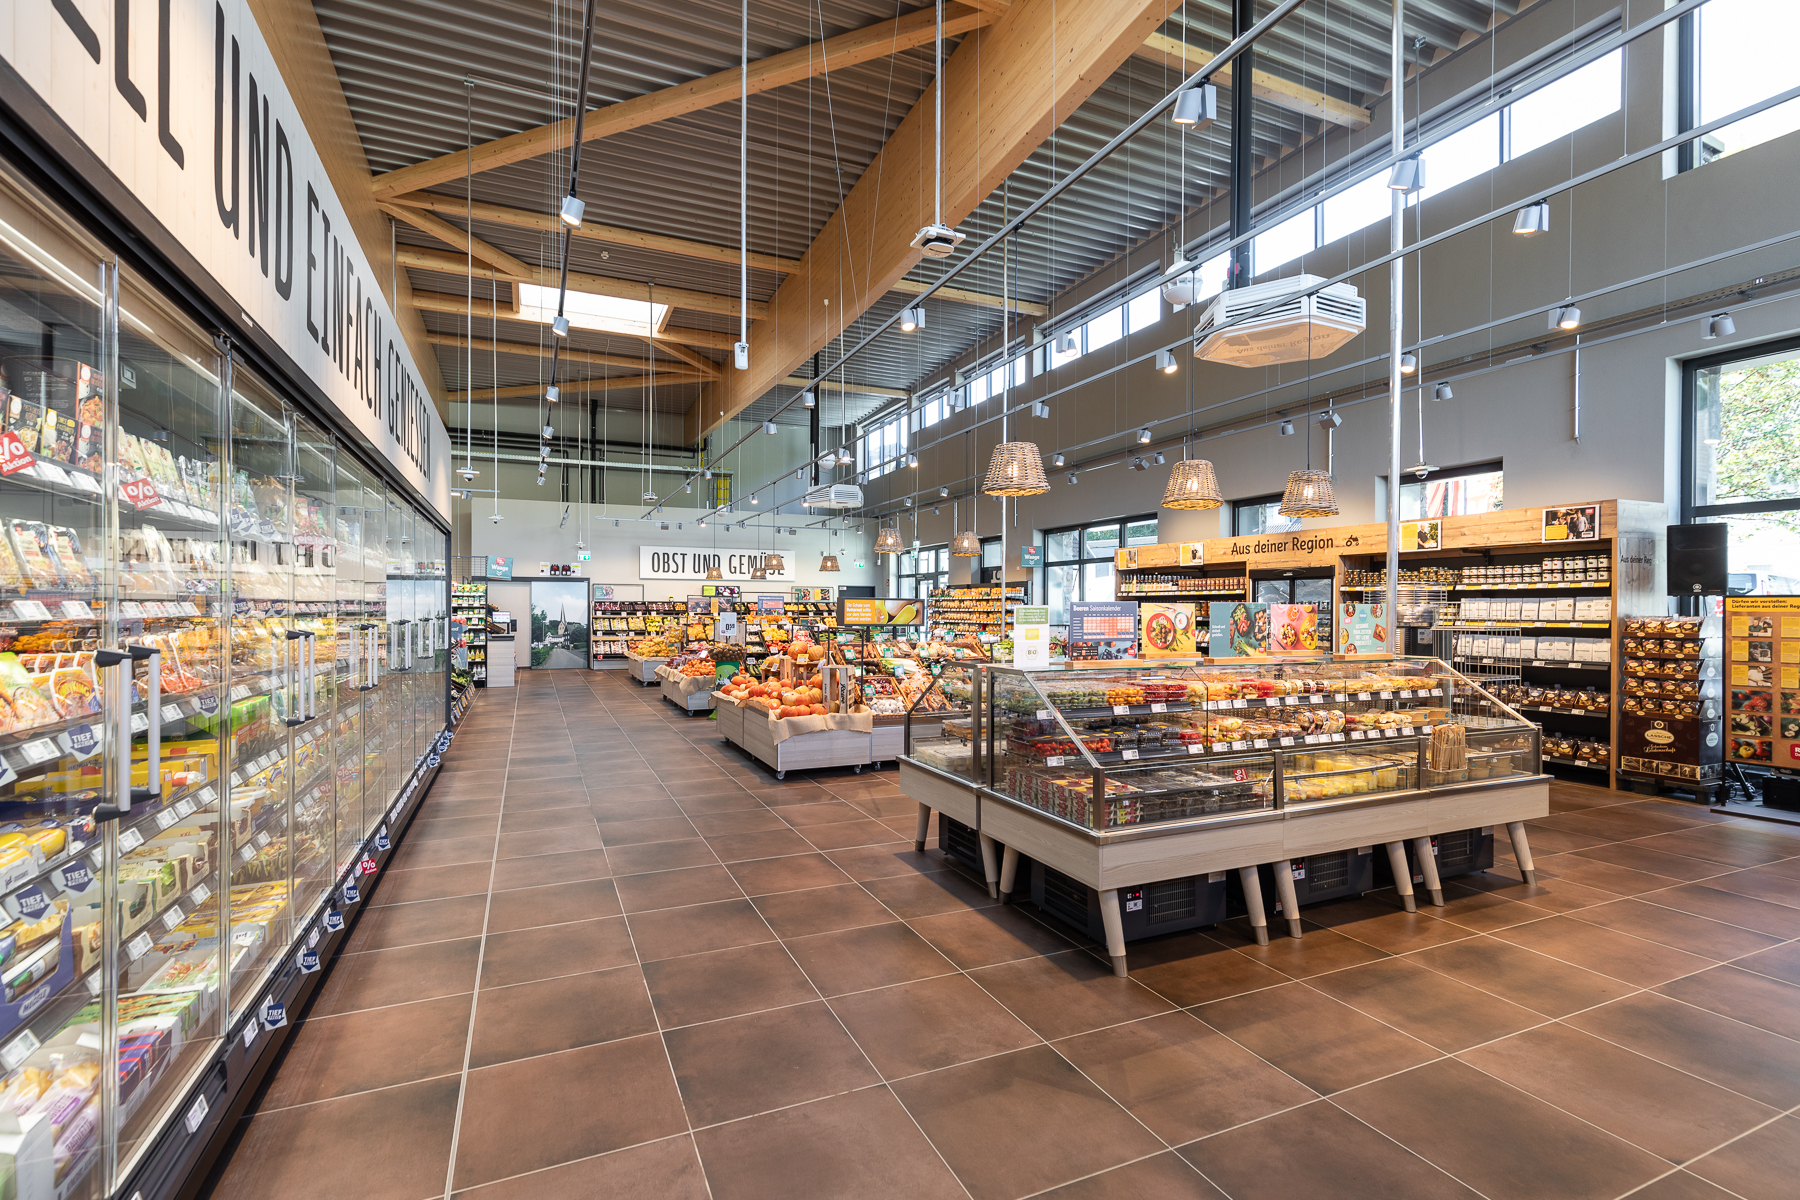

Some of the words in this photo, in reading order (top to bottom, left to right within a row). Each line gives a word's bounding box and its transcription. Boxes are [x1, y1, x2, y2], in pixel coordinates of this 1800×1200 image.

[214, 0, 293, 301] UND
[307, 180, 382, 420] EINFACH
[388, 338, 431, 482] GENIESSEN
[2, 455, 32, 472] Aktion
[1231, 542, 1250, 556] Aus
[1254, 540, 1288, 554] deiner
[1292, 535, 1334, 554] Region
[491, 563, 509, 572] Waage
[651, 552, 687, 573] OBST
[72, 732, 92, 742] TIEF
[64, 869, 86, 880] TIEF
[20, 894, 42, 905] TIEF
